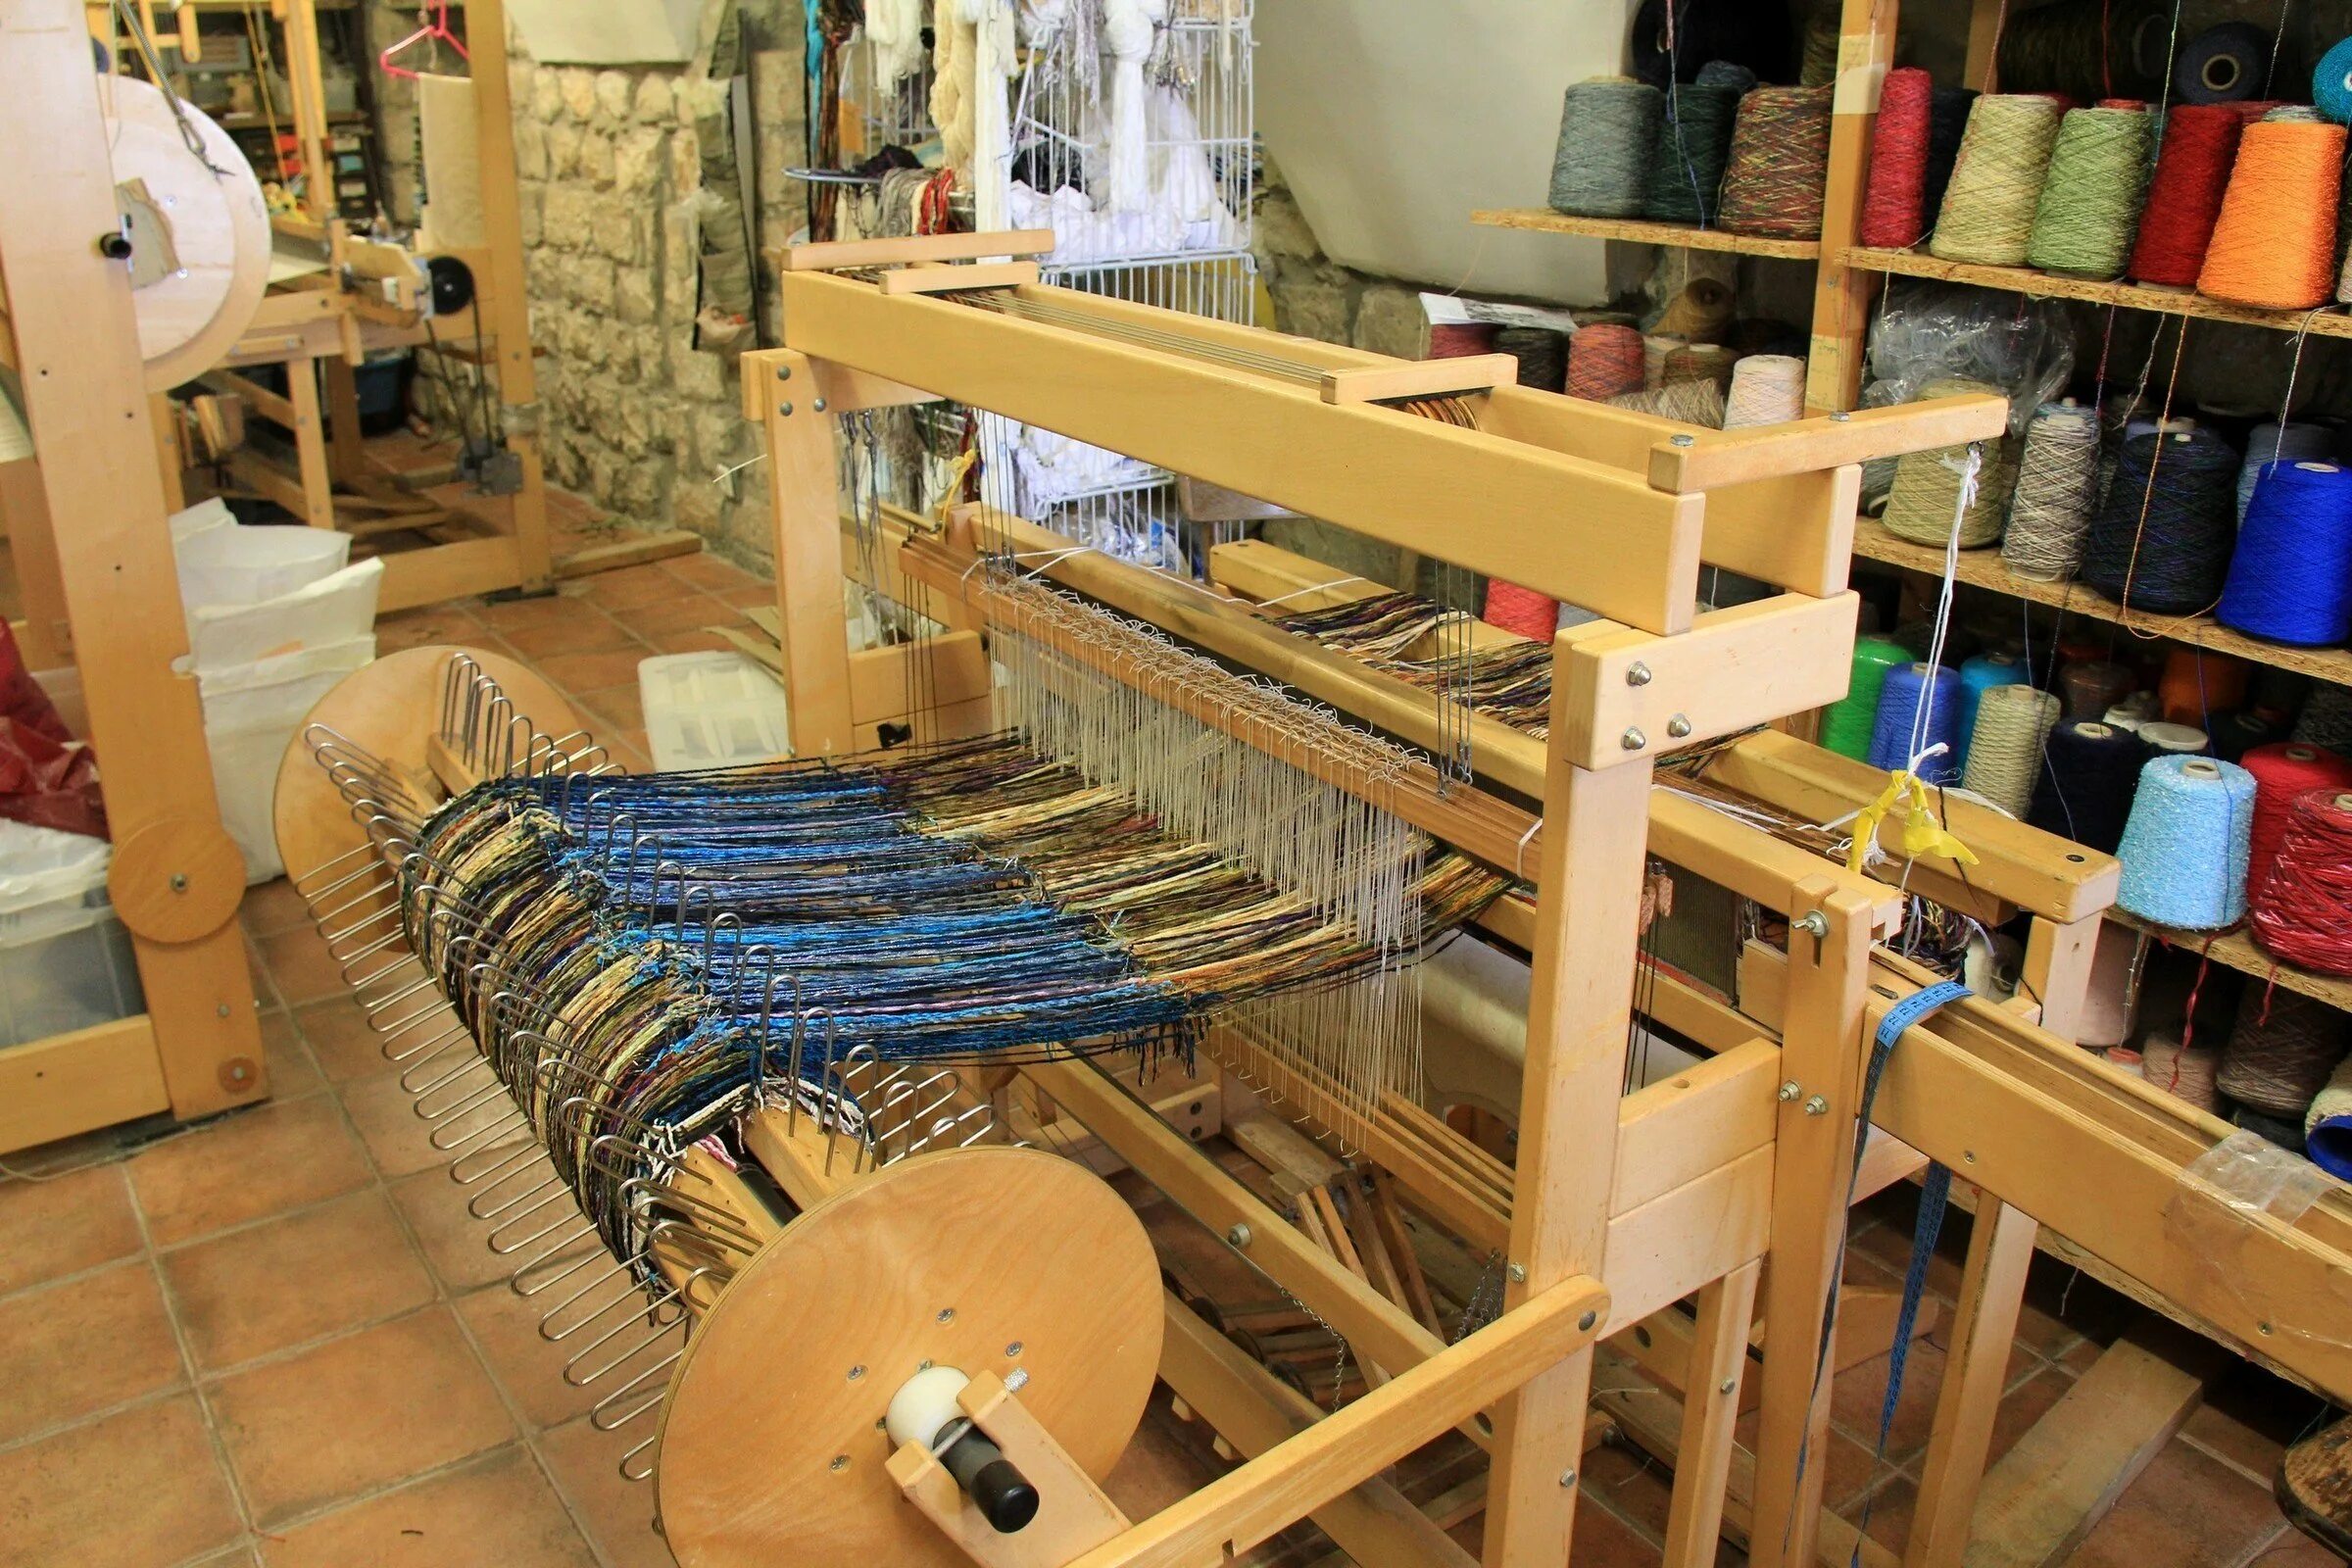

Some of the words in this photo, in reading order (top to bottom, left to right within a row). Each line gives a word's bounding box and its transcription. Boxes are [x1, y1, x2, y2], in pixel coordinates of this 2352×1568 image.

[1887, 1016, 1897, 1026] 72
[1899, 1006, 1910, 1016] 73
[1910, 1001, 1922, 1009] 74
